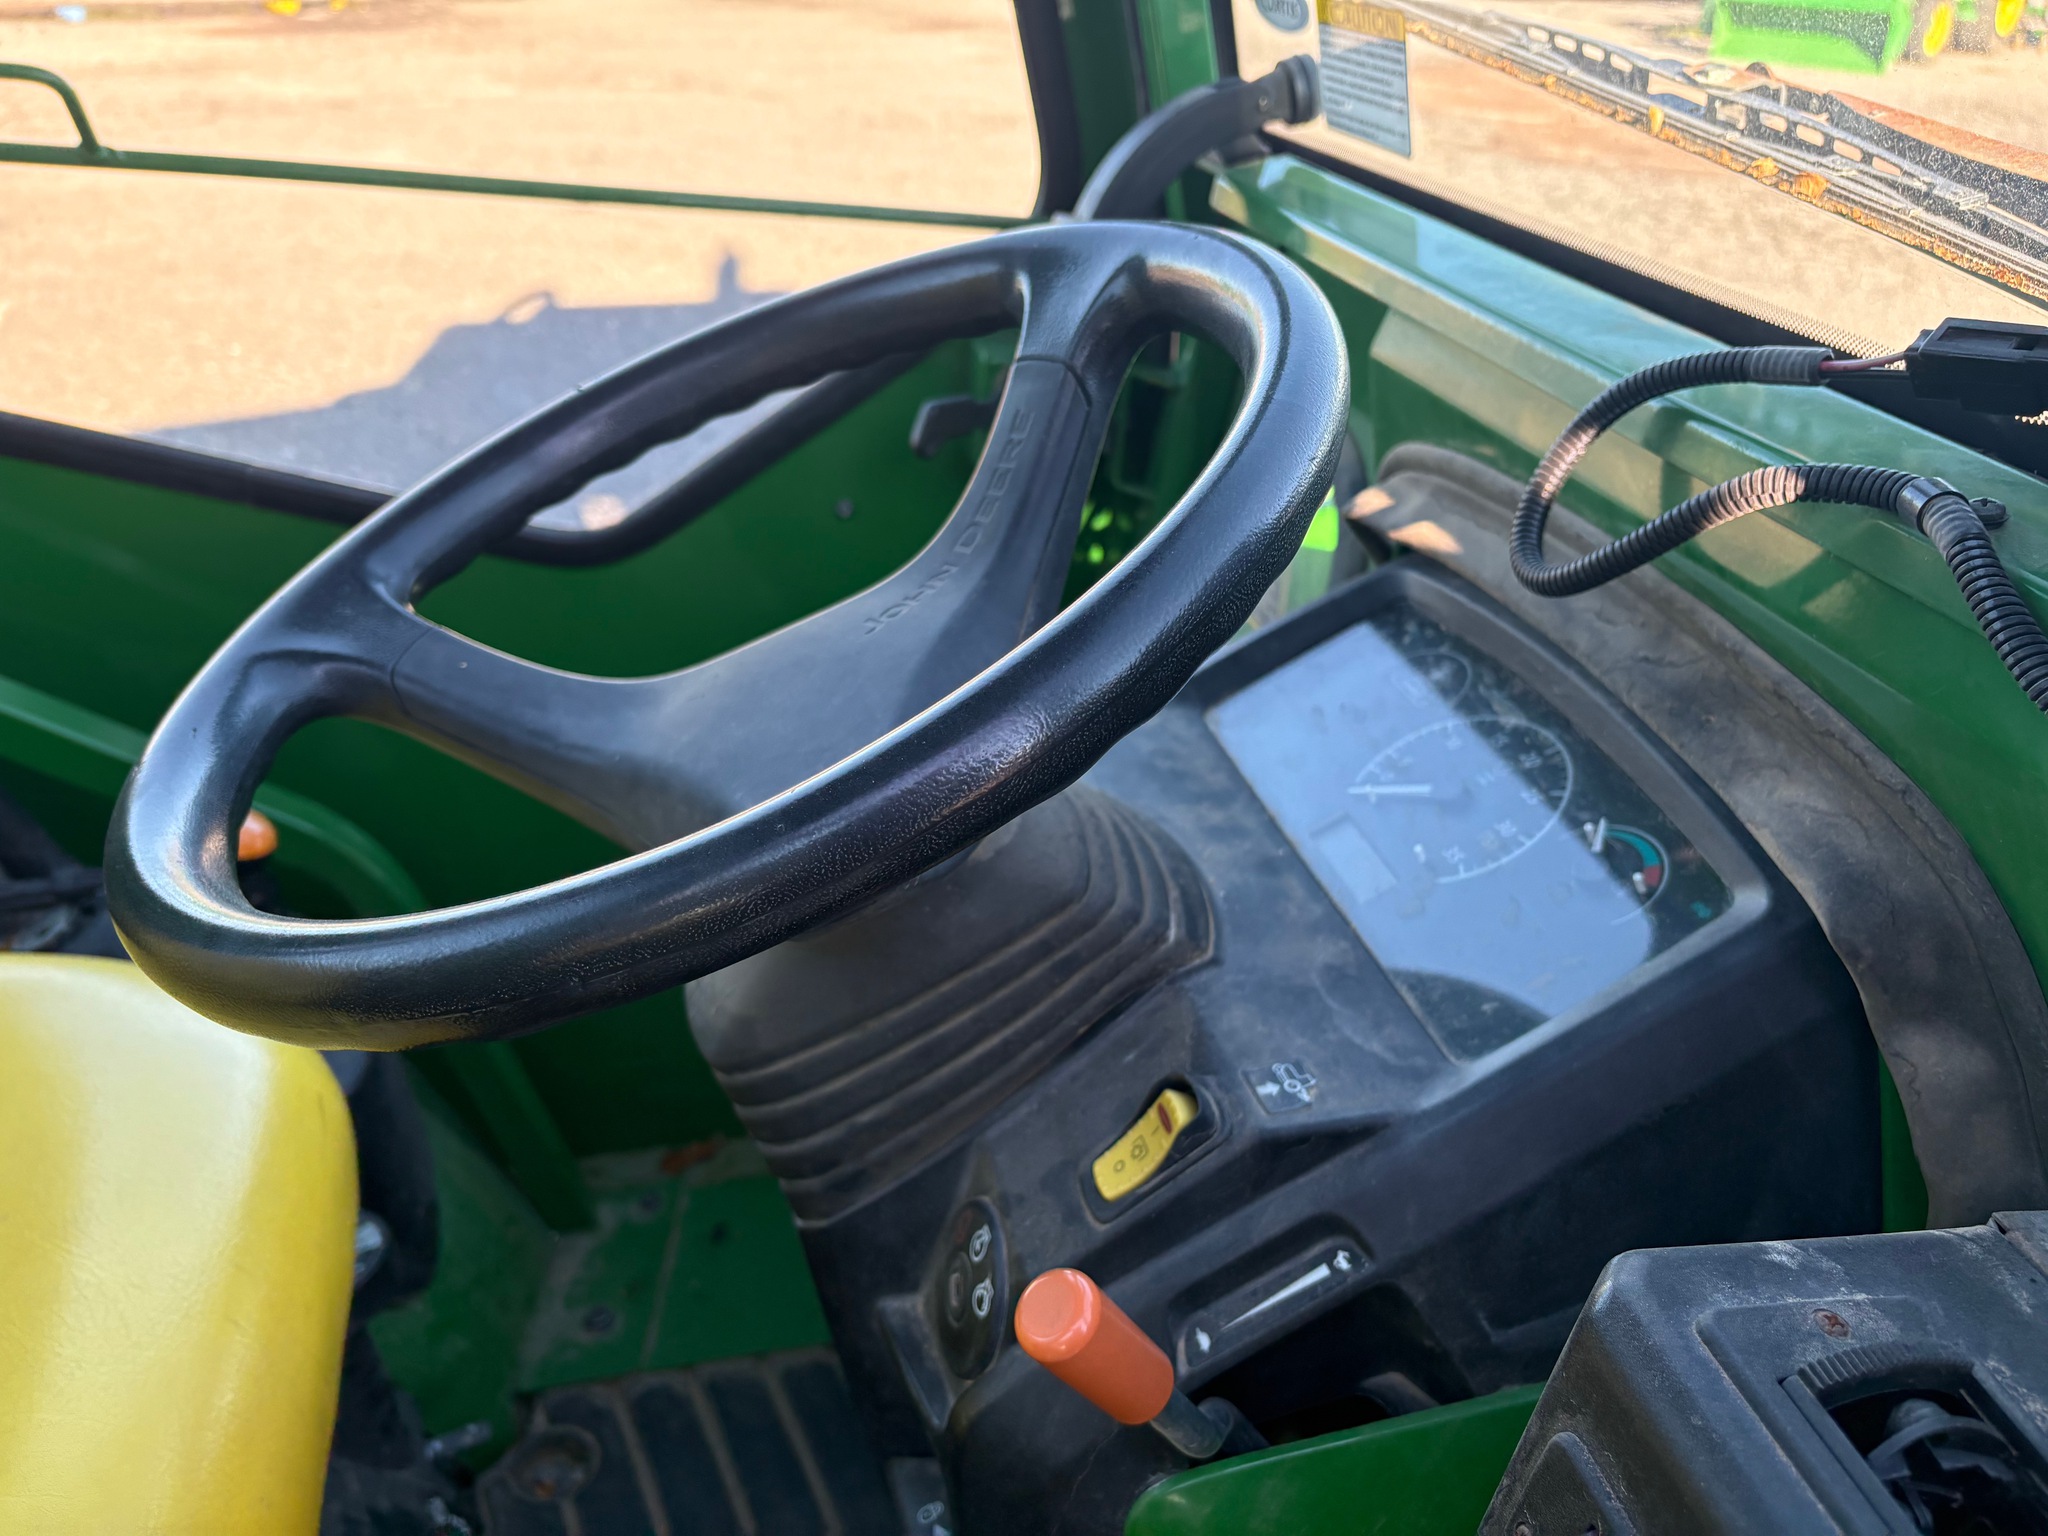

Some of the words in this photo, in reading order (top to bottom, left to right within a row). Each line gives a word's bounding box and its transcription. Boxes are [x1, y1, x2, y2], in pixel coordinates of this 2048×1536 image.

[1330, 3, 1397, 37] CAUTION
[863, 563, 960, 636] JOHN
[953, 409, 1036, 555] DEERE
